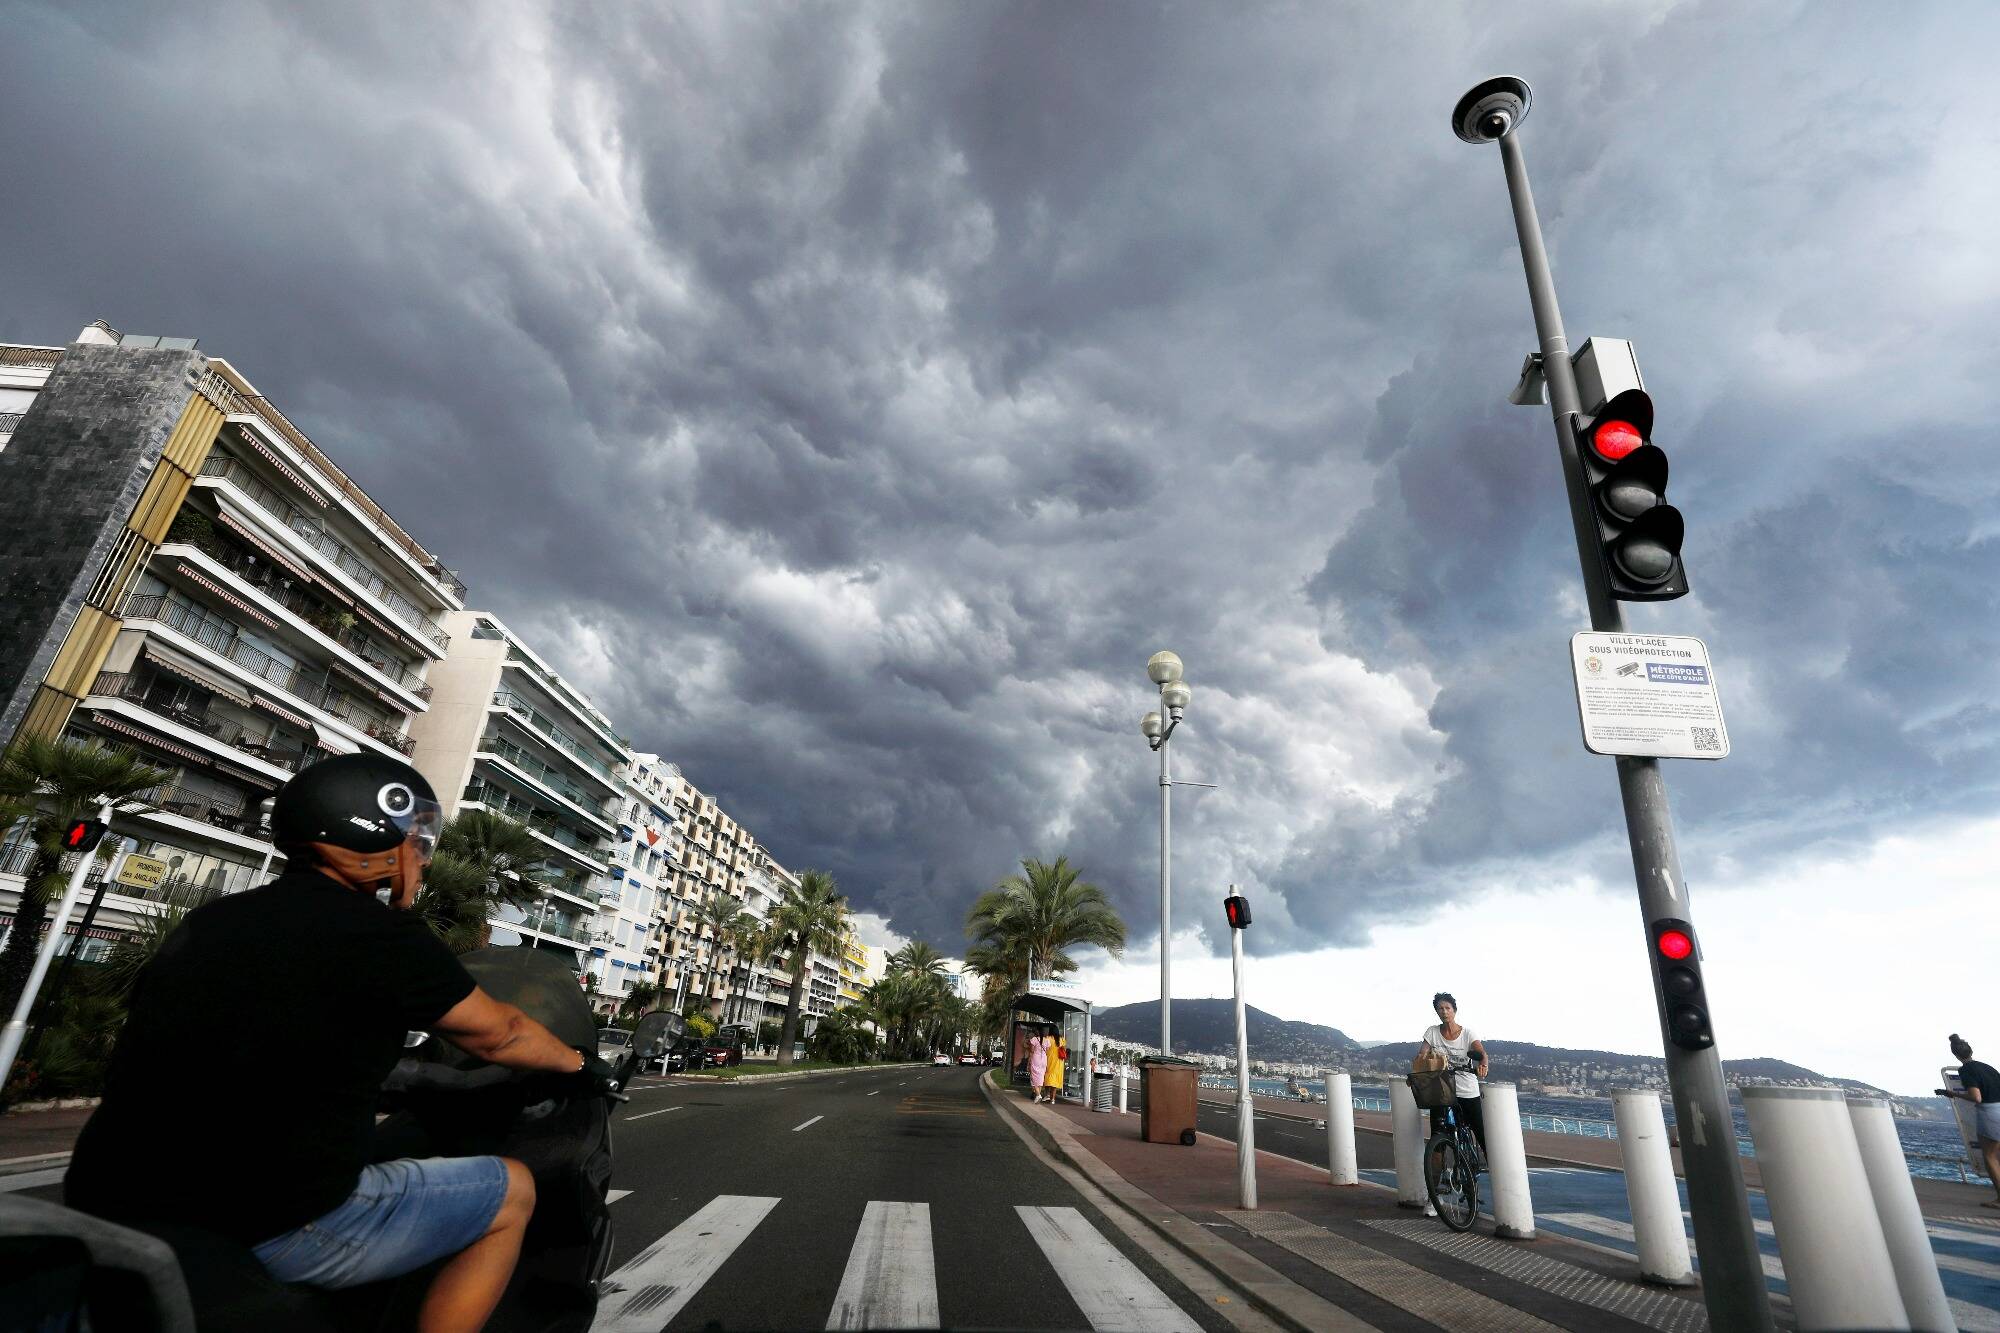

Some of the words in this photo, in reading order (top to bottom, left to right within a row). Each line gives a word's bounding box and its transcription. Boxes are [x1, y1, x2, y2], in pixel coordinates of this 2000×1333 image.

[1609, 636, 1633, 645] VILLE
[1636, 638, 1667, 647] PLACÉE
[1589, 645, 1612, 654] SOUS
[1614, 646, 1692, 658] VIDÉOPROTECTION
[1650, 665, 1703, 676] MÉTROPOLE
[136, 861, 163, 874] PROMENADE
[122, 870, 132, 878] des
[133, 872, 159, 885] ANGLAIS
